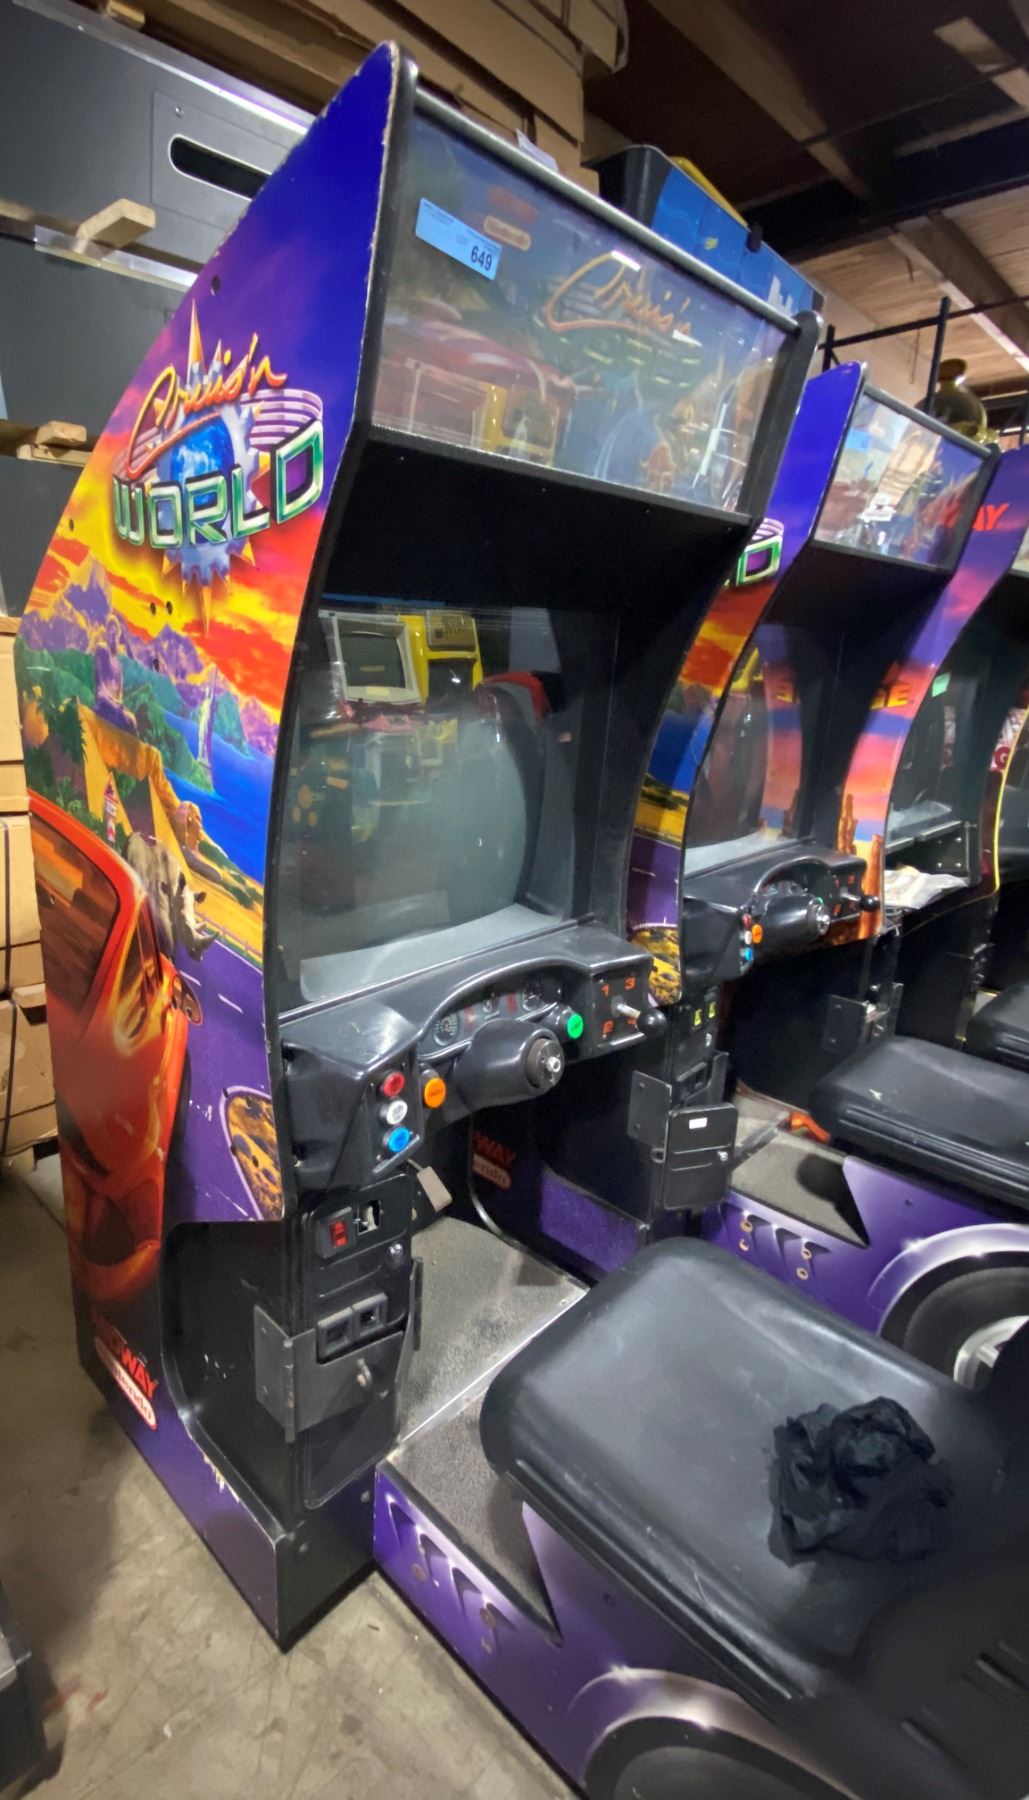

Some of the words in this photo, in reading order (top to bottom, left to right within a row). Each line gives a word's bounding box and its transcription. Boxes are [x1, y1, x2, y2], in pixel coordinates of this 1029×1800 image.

[470, 245, 493, 272] 649
[126, 332, 288, 480] Cruis'n
[111, 417, 324, 549] WORLD
[601, 983, 609, 997] 1
[624, 976, 635, 991] 3
